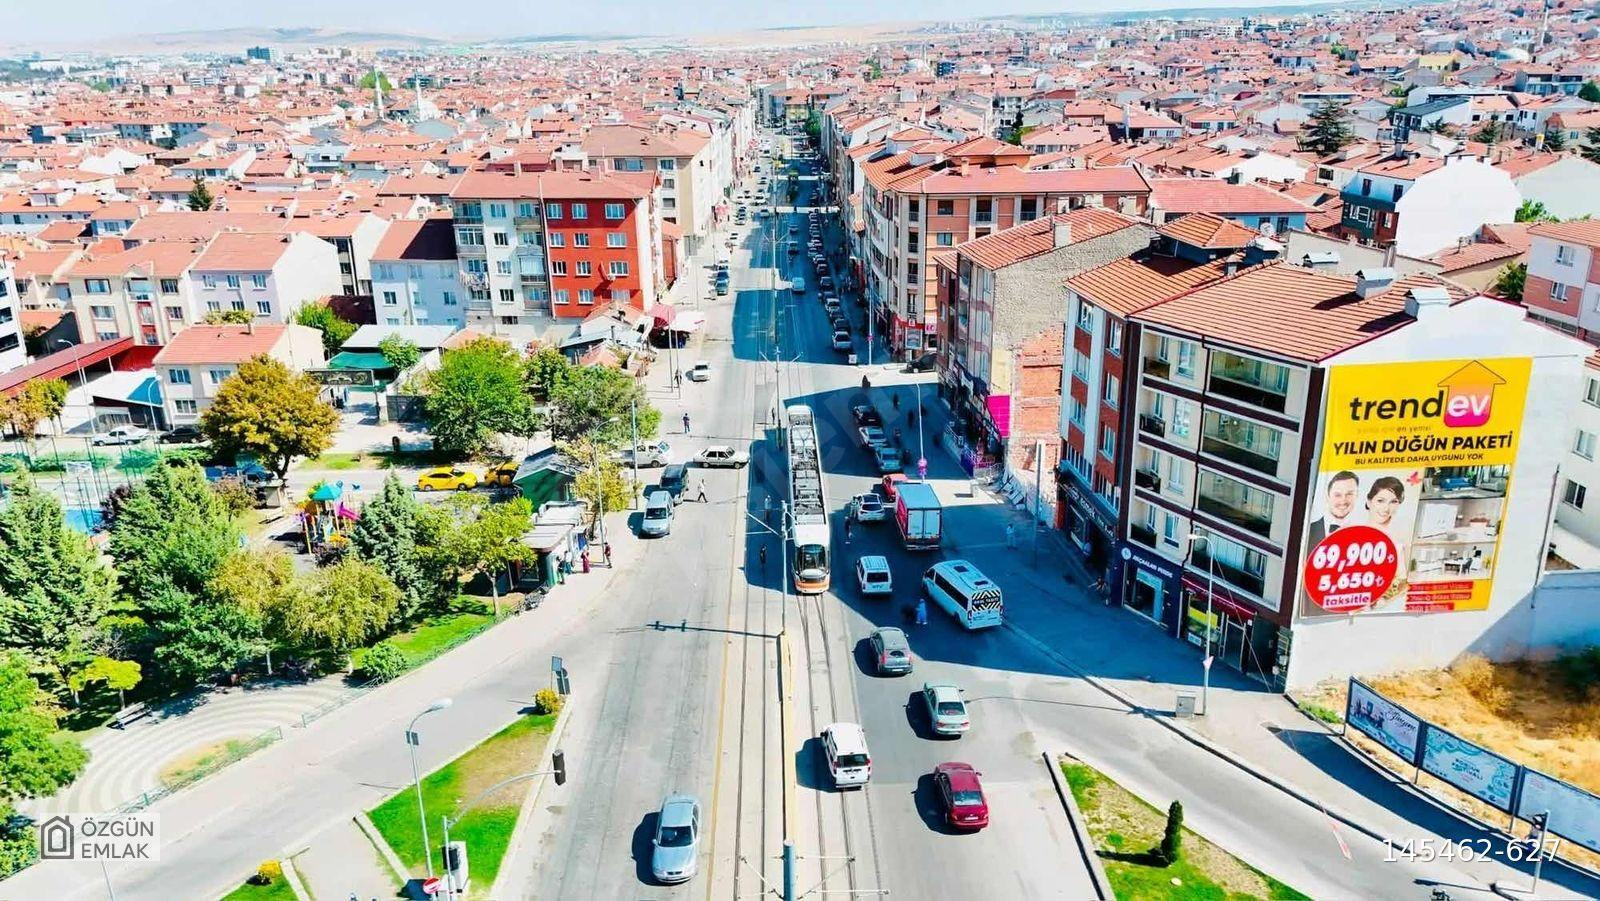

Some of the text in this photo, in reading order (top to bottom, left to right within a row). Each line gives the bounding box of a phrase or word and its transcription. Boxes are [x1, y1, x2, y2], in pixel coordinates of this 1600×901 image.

[1333, 430, 1513, 456] YILIN DÜĞÜN PAKETİ
[1355, 452, 1484, 465] BU KALİTEDE DAHA UYGUNU YOK
[1325, 594, 1369, 606] taksitle
